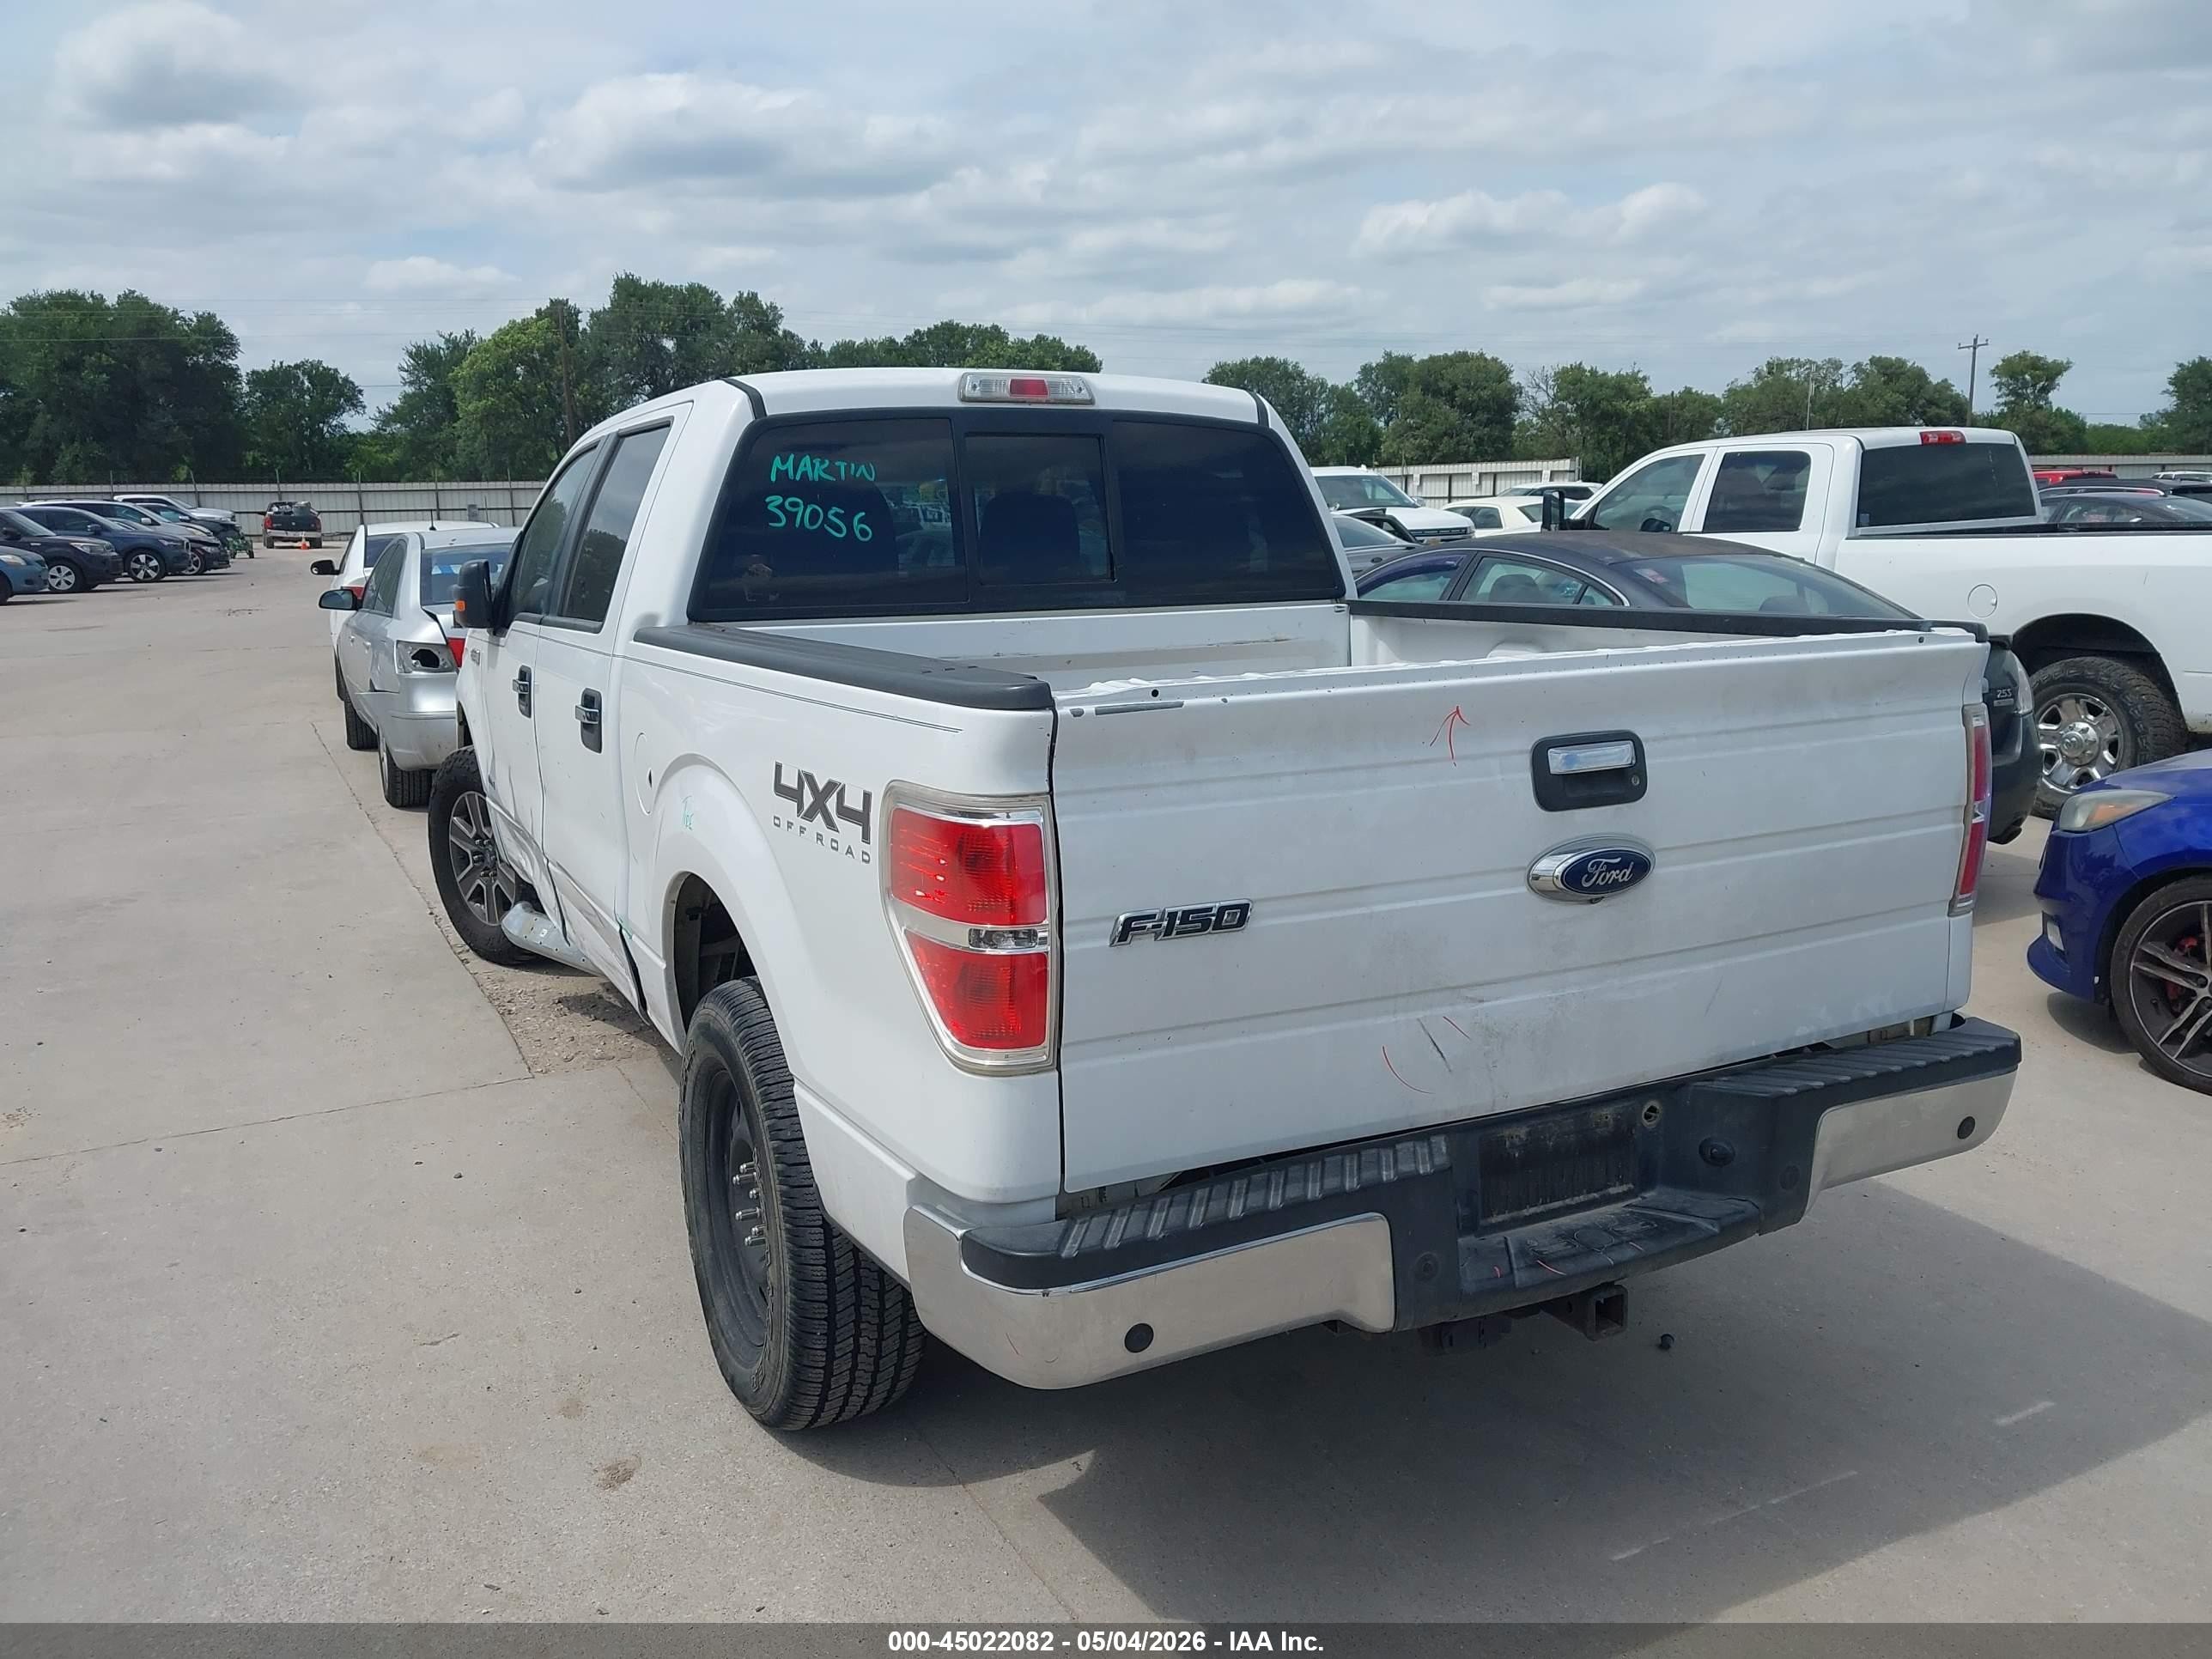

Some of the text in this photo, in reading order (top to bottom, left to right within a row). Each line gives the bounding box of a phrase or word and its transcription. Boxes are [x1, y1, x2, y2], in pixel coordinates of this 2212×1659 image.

[771, 453, 875, 481] MARTIN
[765, 495, 872, 541] 39056
[1581, 857, 1634, 887] Ford
[1110, 898, 1252, 947] F-150
